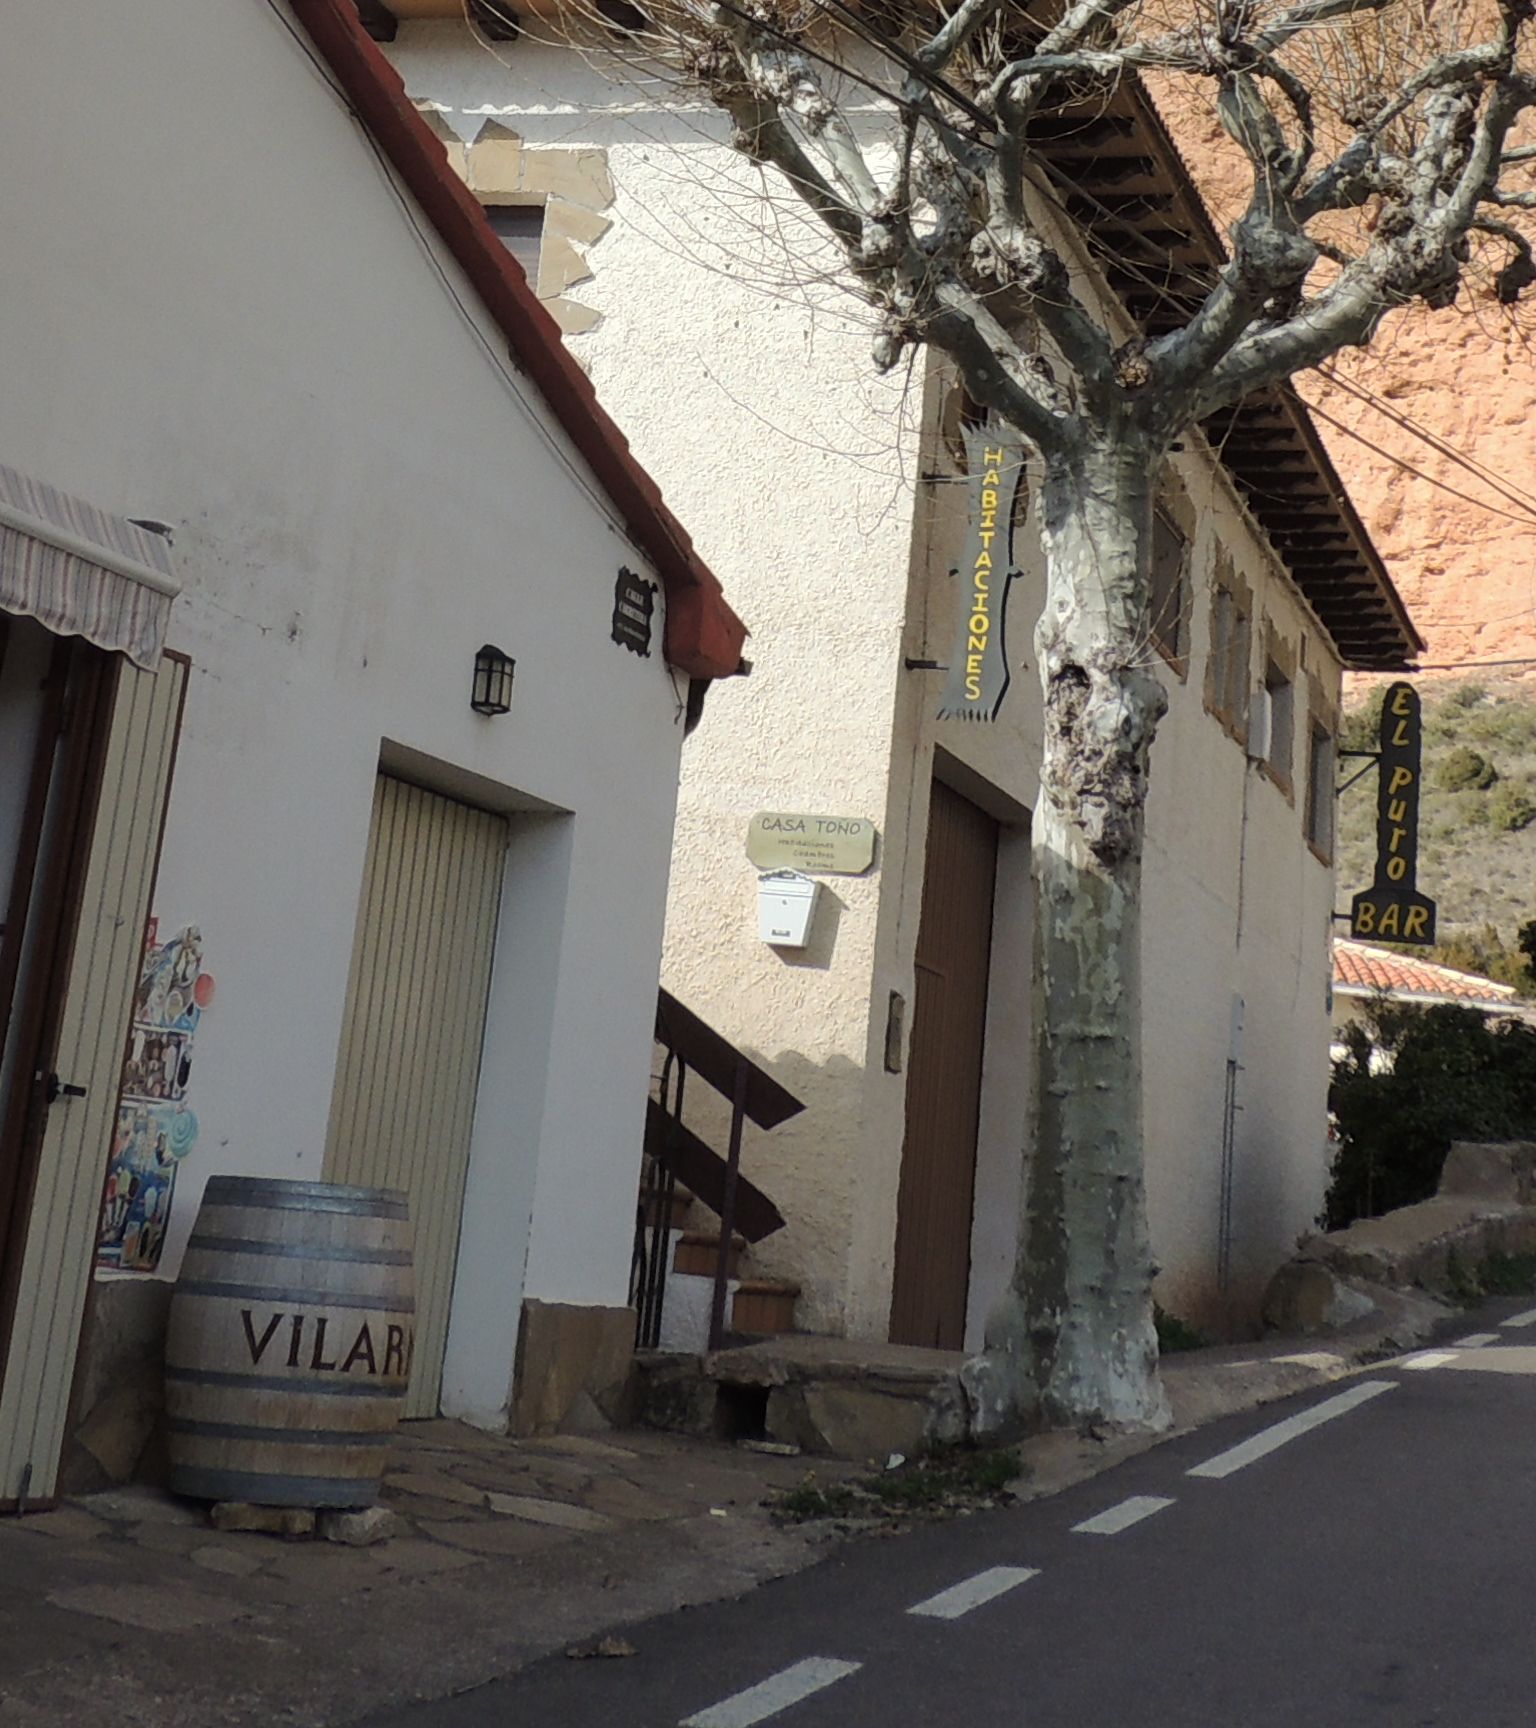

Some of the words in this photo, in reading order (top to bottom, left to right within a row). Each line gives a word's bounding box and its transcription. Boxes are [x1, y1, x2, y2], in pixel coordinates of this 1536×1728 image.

[963, 446, 1003, 701] HABITACIONES
[1390, 687, 1413, 746] EL
[761, 817, 806, 834] CASA
[1354, 901, 1429, 939] BAR
